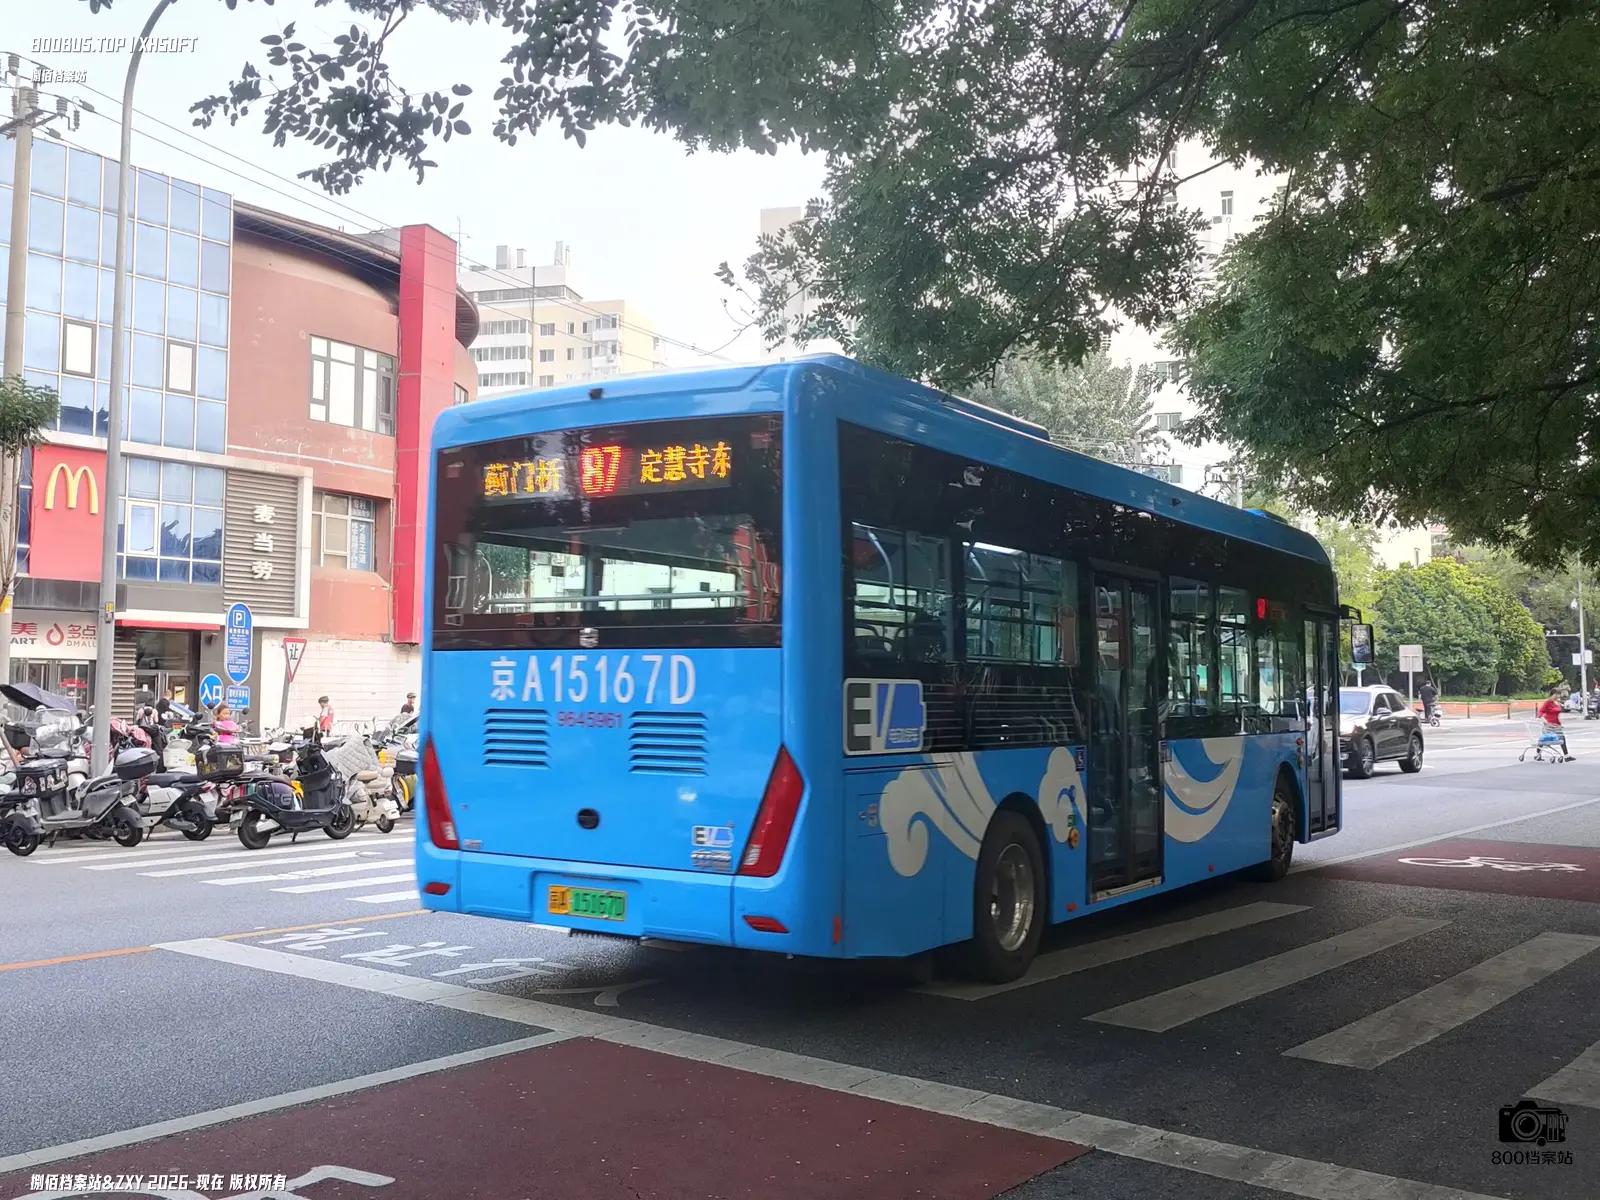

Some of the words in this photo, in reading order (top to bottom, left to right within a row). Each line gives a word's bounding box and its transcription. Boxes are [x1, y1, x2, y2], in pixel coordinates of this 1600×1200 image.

[581, 445, 622, 494] 87
[639, 441, 732, 484] 定慧寺东
[252, 504, 276, 580] 麦当劳
[66, 640, 97, 648] DMALL
[67, 623, 97, 640] 多点
[289, 643, 299, 661] 让
[201, 682, 223, 701] 入口
[490, 654, 697, 705] 京A15167D
[257, 926, 661, 1007] 礼让行人
